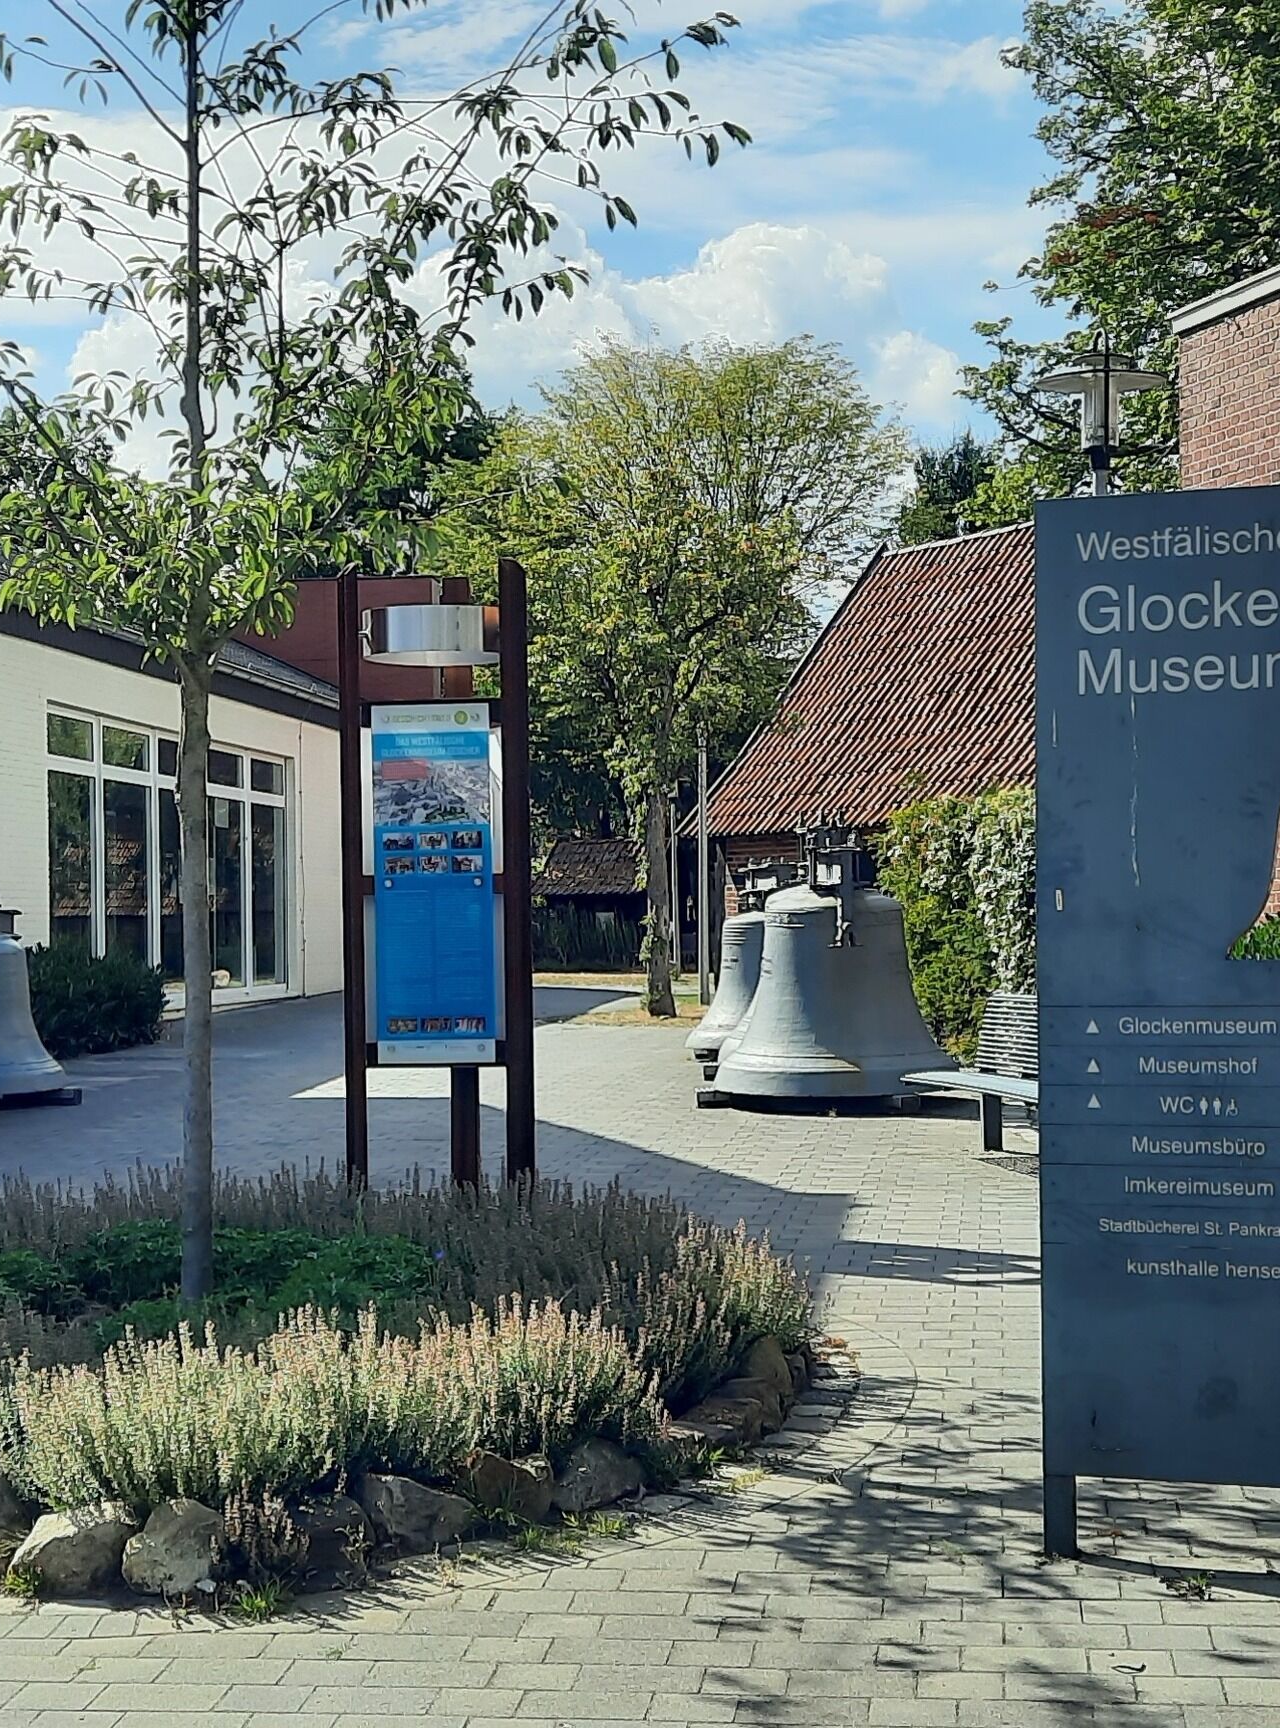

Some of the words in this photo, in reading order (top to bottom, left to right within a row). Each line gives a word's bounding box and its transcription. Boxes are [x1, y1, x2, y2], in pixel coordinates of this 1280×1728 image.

[1118, 1016, 1278, 1035] Glockenmuseum
[1138, 1056, 1259, 1074] Museumshof
[1159, 1096, 1195, 1114] WC
[1131, 1135, 1266, 1156] Museumsbüro
[1123, 1175, 1275, 1196] Imkereimuseum
[1098, 1218, 1200, 1235] Stadtbücherei
[1204, 1220, 1224, 1236] St.
[1126, 1257, 1219, 1278] kunsthalle
